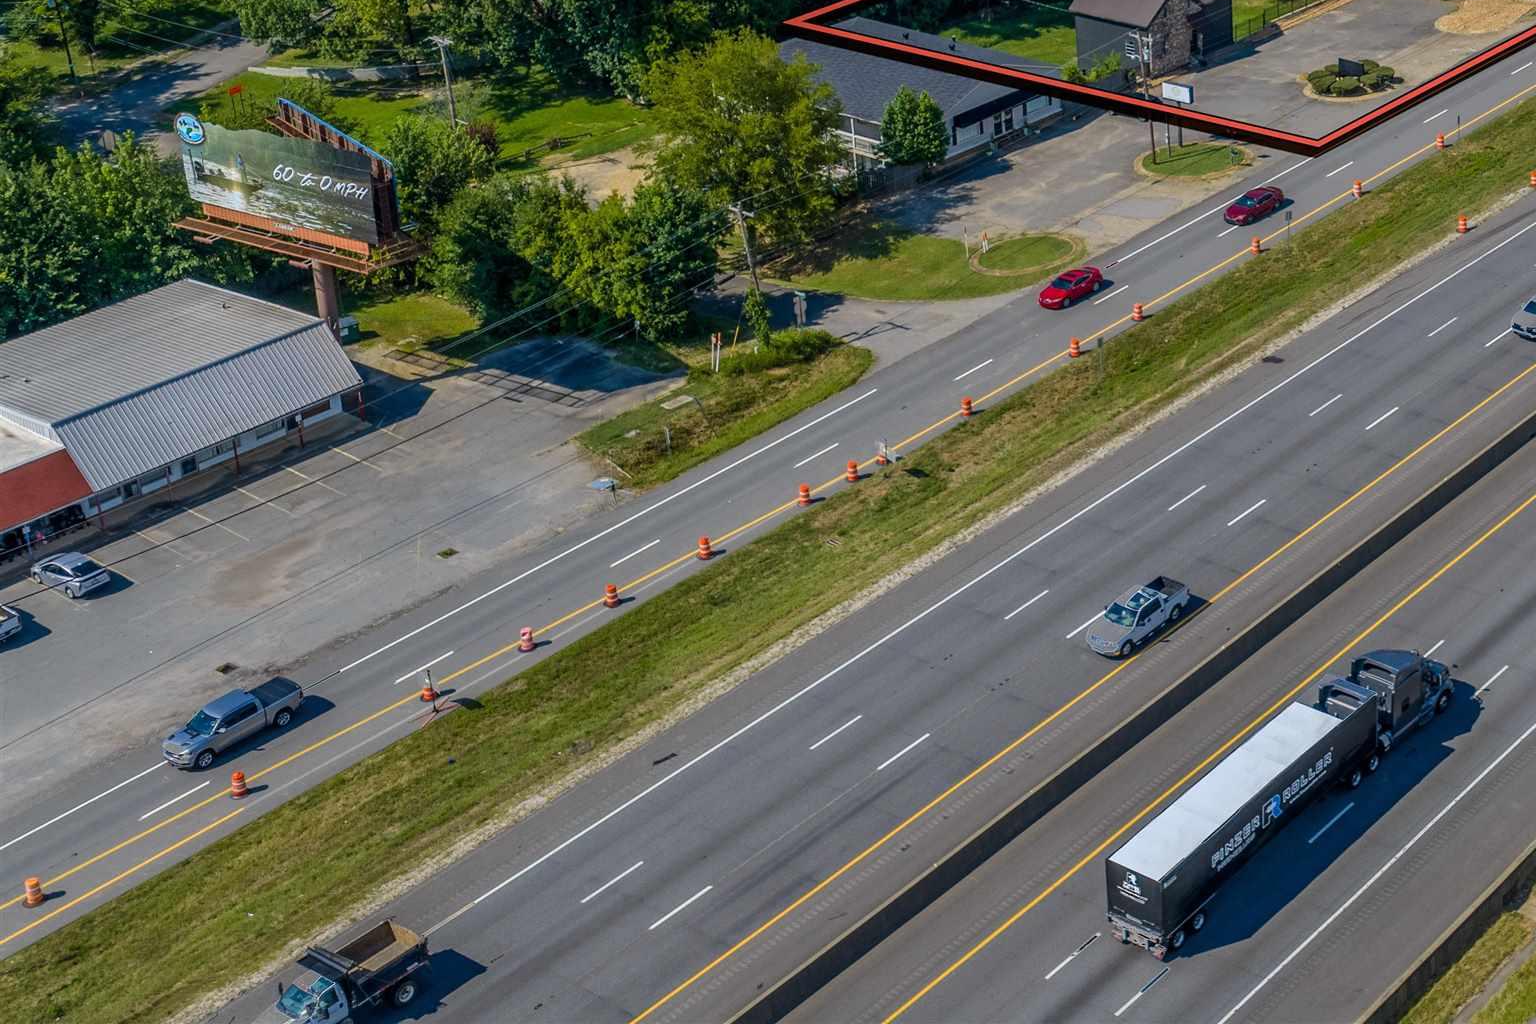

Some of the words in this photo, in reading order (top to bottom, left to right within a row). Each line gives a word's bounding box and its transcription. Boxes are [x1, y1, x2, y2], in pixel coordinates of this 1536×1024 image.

[272, 163, 295, 183] 60
[319, 175, 331, 192] 0
[333, 182, 370, 200] MPH
[1211, 814, 1261, 869] FINZER
[1282, 751, 1333, 803] ROLLER
